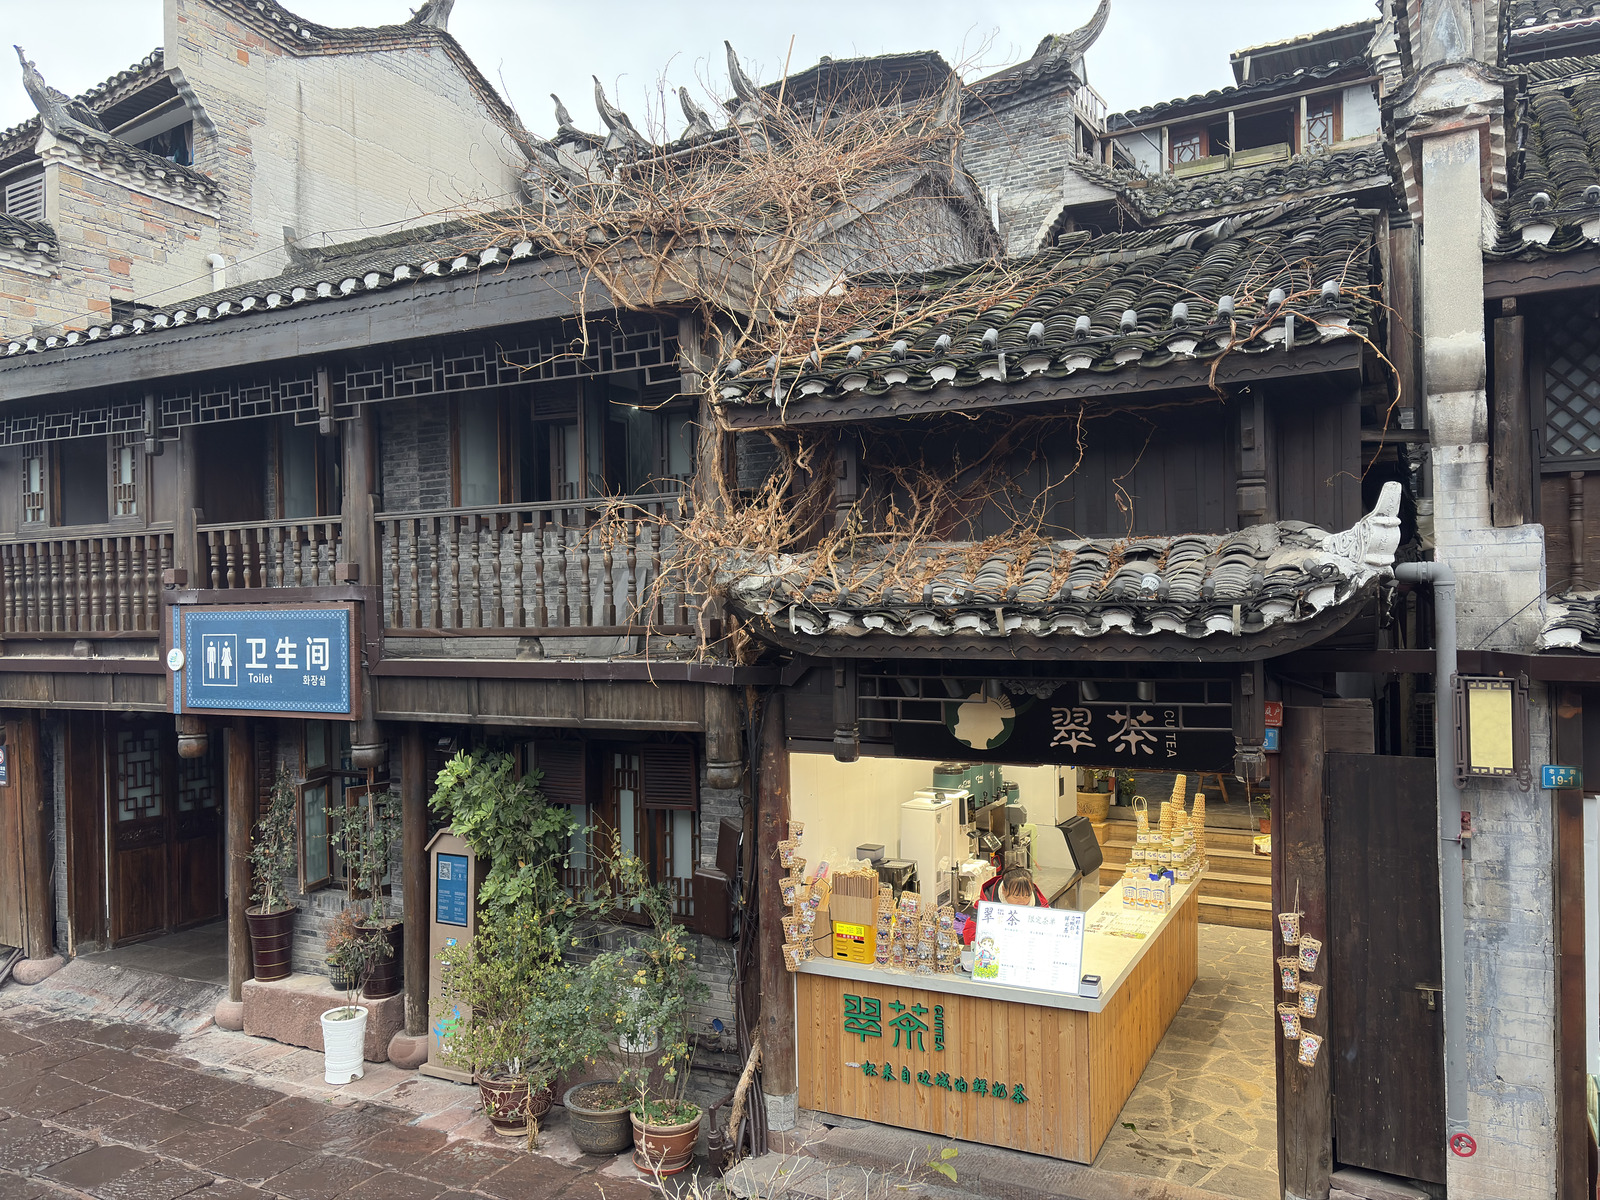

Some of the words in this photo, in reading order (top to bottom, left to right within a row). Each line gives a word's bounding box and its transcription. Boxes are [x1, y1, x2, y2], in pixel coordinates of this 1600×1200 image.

[245, 636, 330, 671] 卫生间
[248, 672, 273, 684] Toilet
[302, 674, 326, 687] 화장실
[1049, 707, 1158, 756] 翠茶
[1550, 775, 1574, 785] 19-1
[843, 993, 929, 1052] 翠茶
